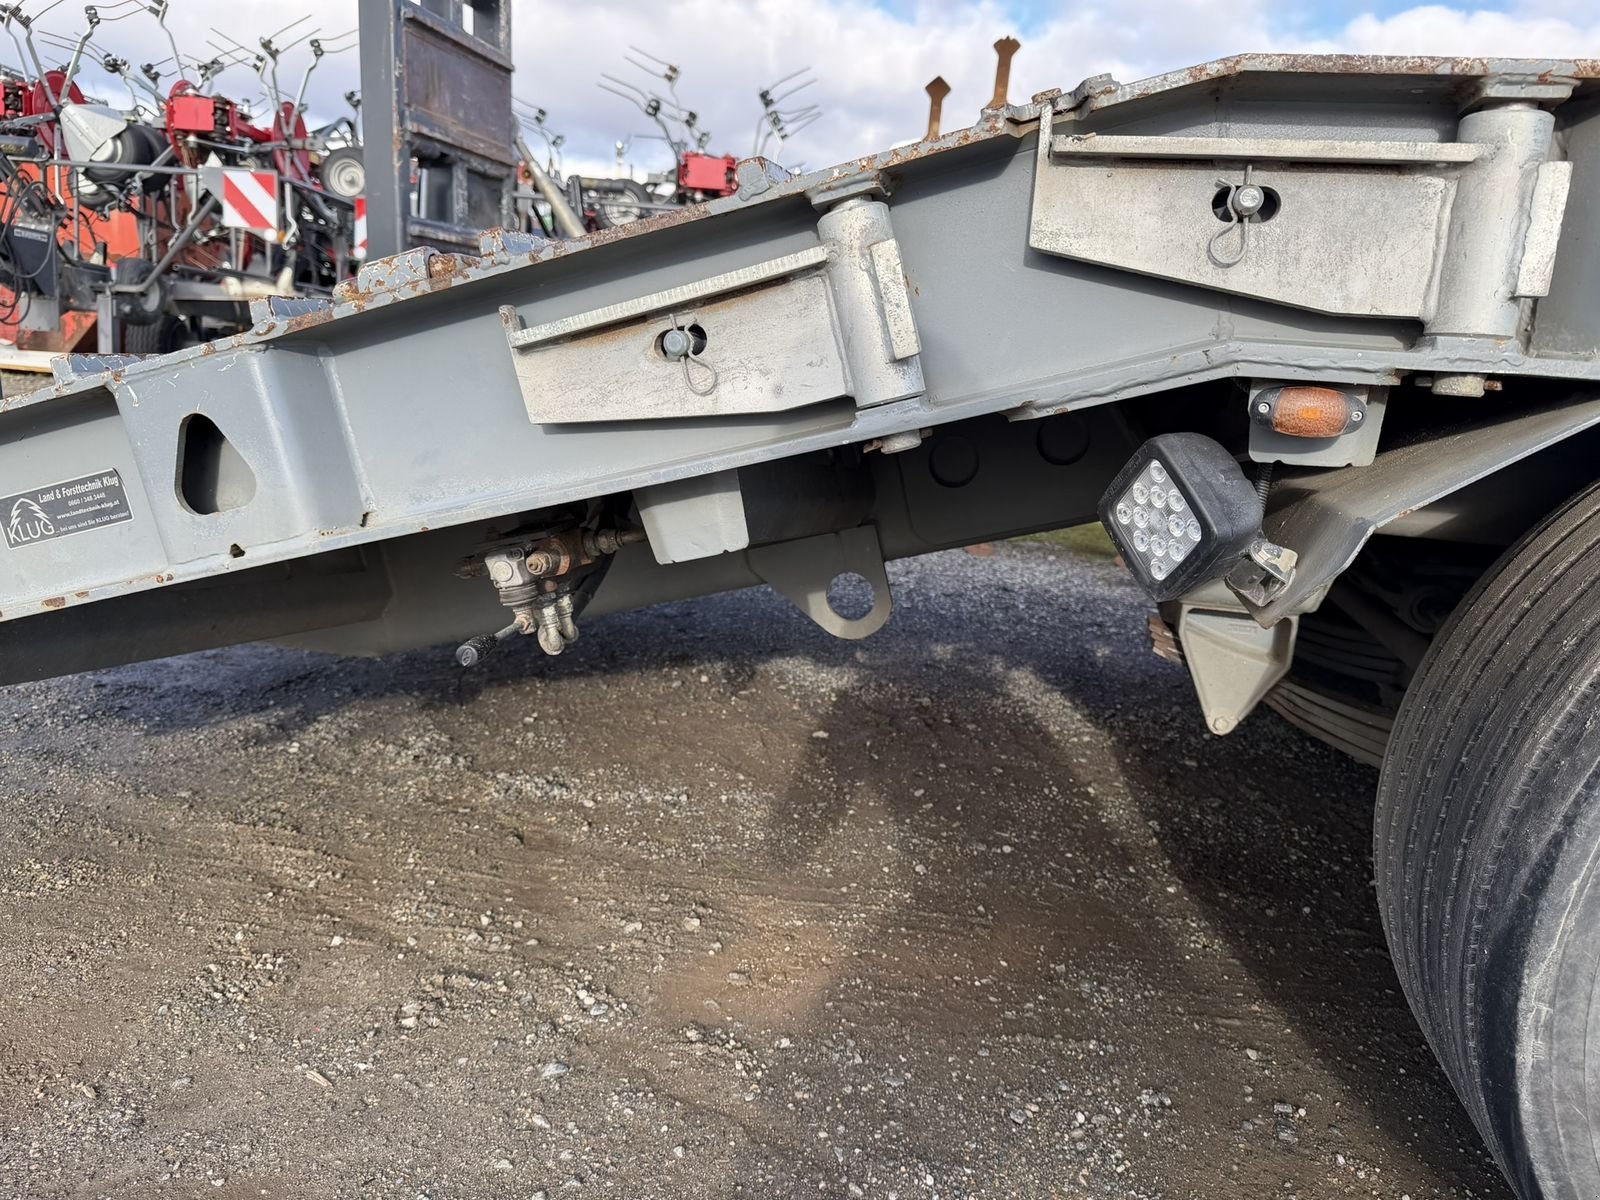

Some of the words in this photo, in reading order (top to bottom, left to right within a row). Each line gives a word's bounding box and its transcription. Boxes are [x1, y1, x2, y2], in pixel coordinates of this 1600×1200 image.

[38, 492, 54, 503] Land
[56, 490, 61, 498] &
[62, 479, 102, 497] Forsttechnik
[102, 476, 119, 486] Klug
[7, 520, 55, 544] KLUG
